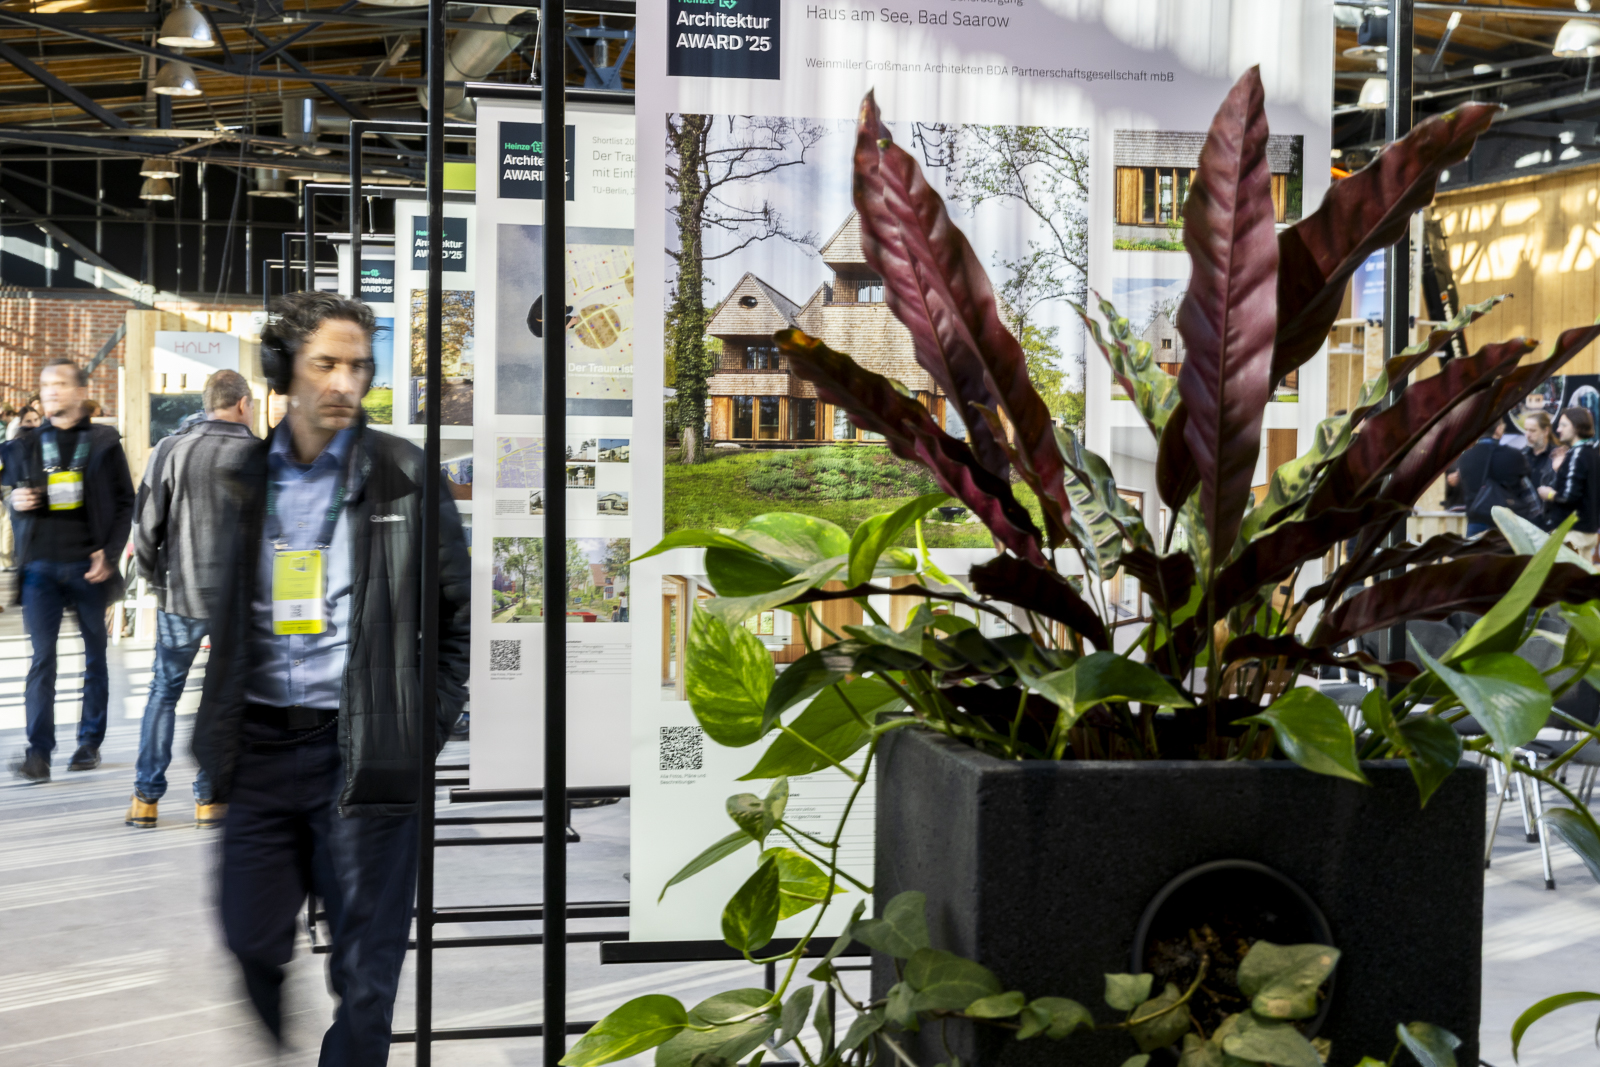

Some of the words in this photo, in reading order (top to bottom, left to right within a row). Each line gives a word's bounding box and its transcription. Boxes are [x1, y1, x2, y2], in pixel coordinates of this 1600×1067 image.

[676, 10, 772, 29] Architektur
[806, 5, 846, 20] Haus
[851, 9, 875, 21] am
[880, 8, 913, 25] See,
[918, 10, 948, 25] Bad
[952, 11, 1010, 28] Saarow
[676, 33, 743, 50] AWARD
[745, 35, 772, 52] '25
[805, 57, 863, 69] Weinmiller
[865, 59, 921, 72] Großmann
[924, 63, 983, 75] Architekten
[986, 65, 1009, 76] BDA
[1011, 66, 1147, 81] Partnerschaftsgesellschaft
[1150, 71, 1174, 82] mbB
[504, 142, 531, 151] Heinze
[592, 136, 623, 145] Shortlist
[624, 138, 635, 146] 20
[592, 150, 612, 161] Der
[614, 151, 636, 163] Trau
[592, 167, 610, 178] mit
[613, 168, 636, 178] Einf
[592, 186, 629, 196] TU-Berlin,
[449, 250, 464, 260] '25
[174, 341, 220, 354] HALM
[568, 363, 586, 372] Der
[588, 363, 619, 373] Traum
